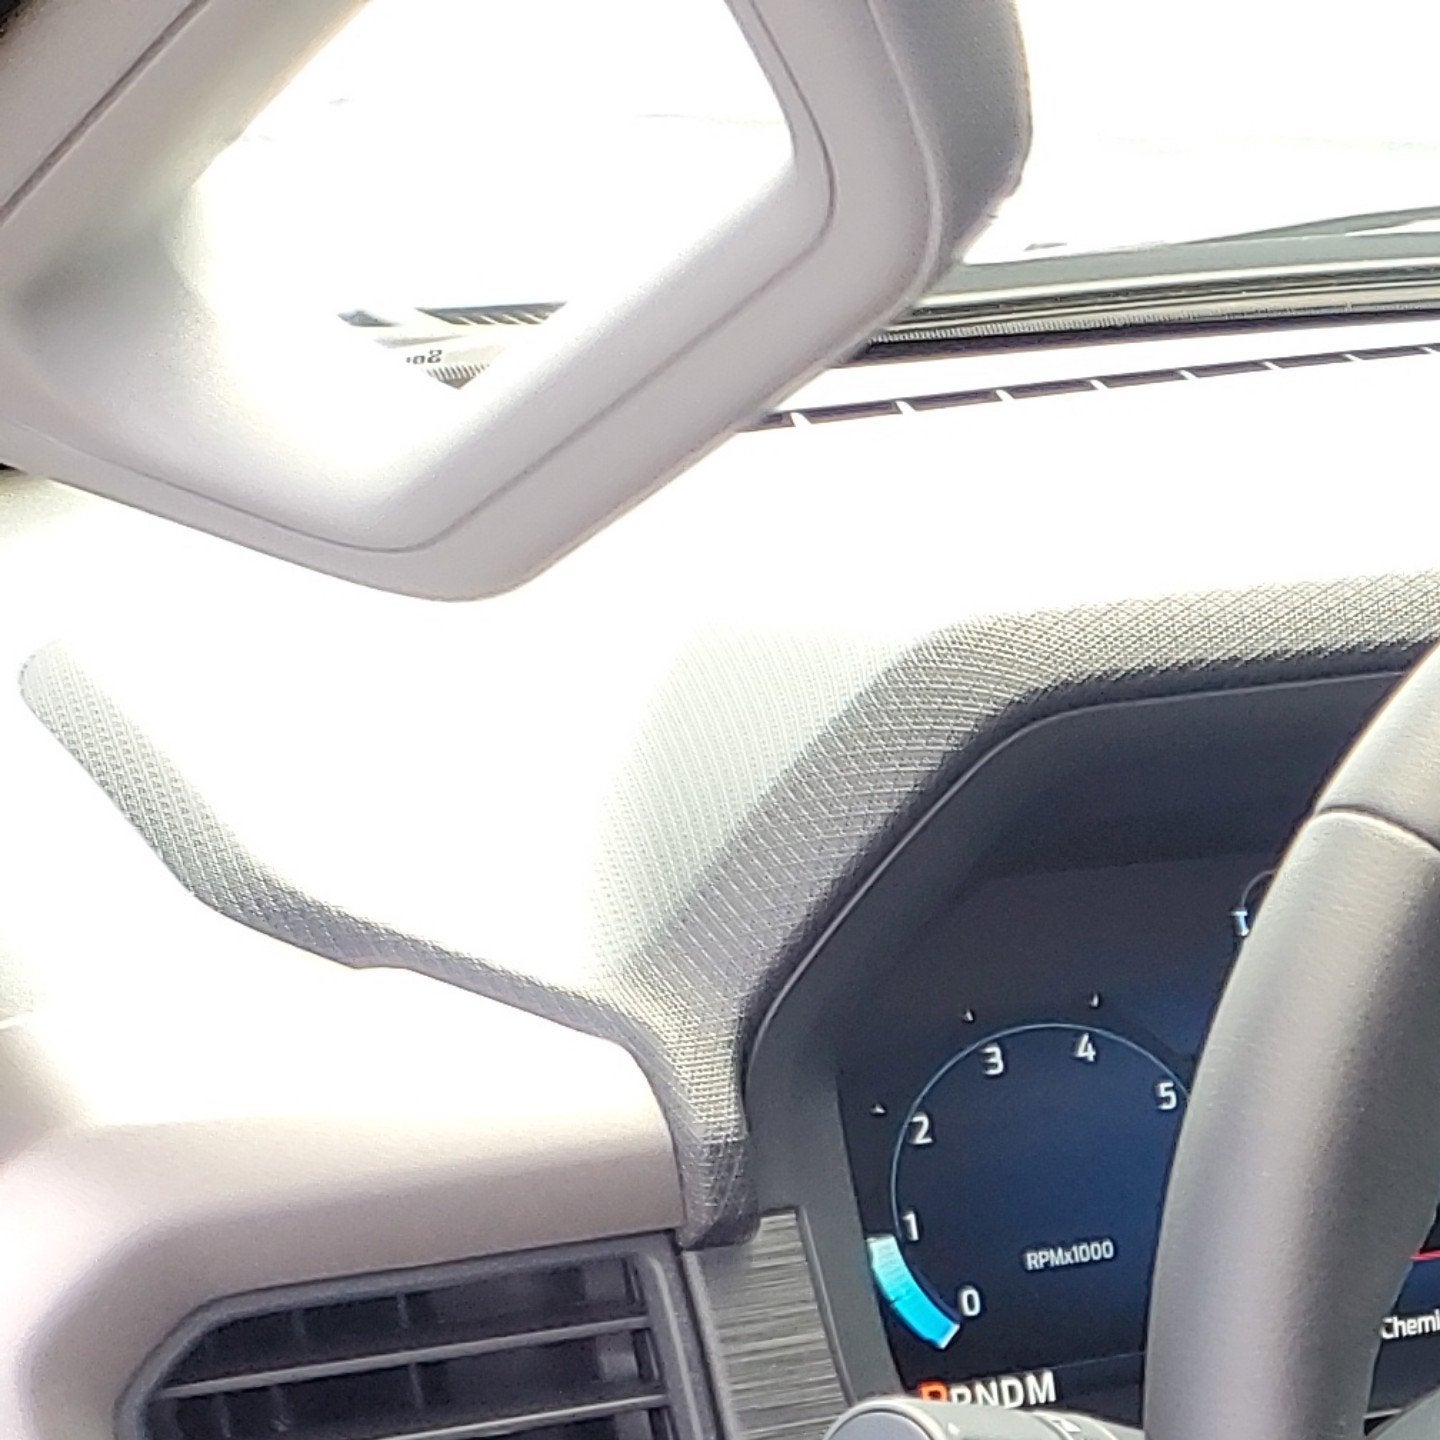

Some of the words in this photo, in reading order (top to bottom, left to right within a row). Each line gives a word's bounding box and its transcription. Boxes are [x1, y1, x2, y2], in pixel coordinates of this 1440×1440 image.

[983, 1044, 1004, 1077] 3
[1075, 1033, 1096, 1063] 4
[1157, 1081, 1178, 1111] 5
[911, 1115, 932, 1146] 2
[904, 1211, 920, 1241] 1
[1025, 1239, 1115, 1272] RPMx1000
[961, 1286, 981, 1317] 0
